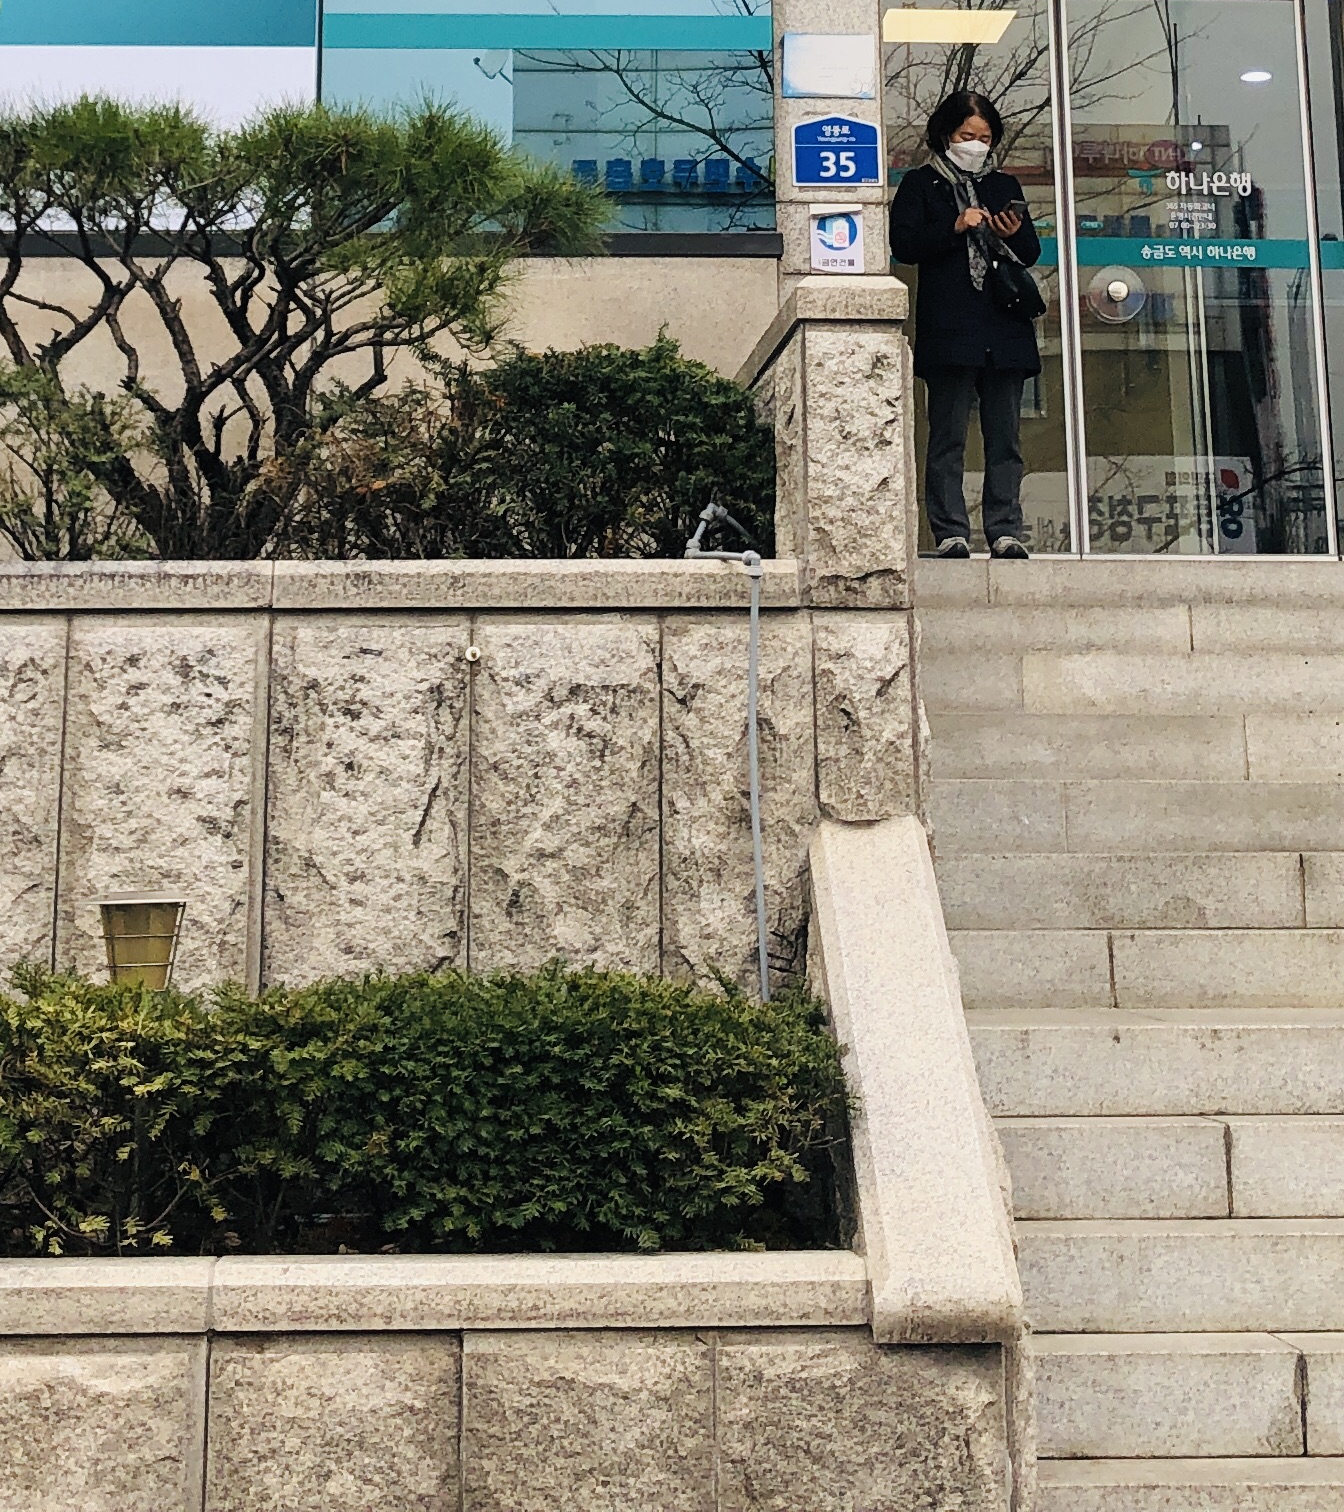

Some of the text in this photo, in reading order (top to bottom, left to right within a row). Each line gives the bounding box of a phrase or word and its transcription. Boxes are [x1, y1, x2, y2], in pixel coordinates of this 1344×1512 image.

[819, 151, 856, 178] 35
[1165, 170, 1252, 197] 하나은행
[1140, 245, 1256, 261] 송금도 역시 하나은행
